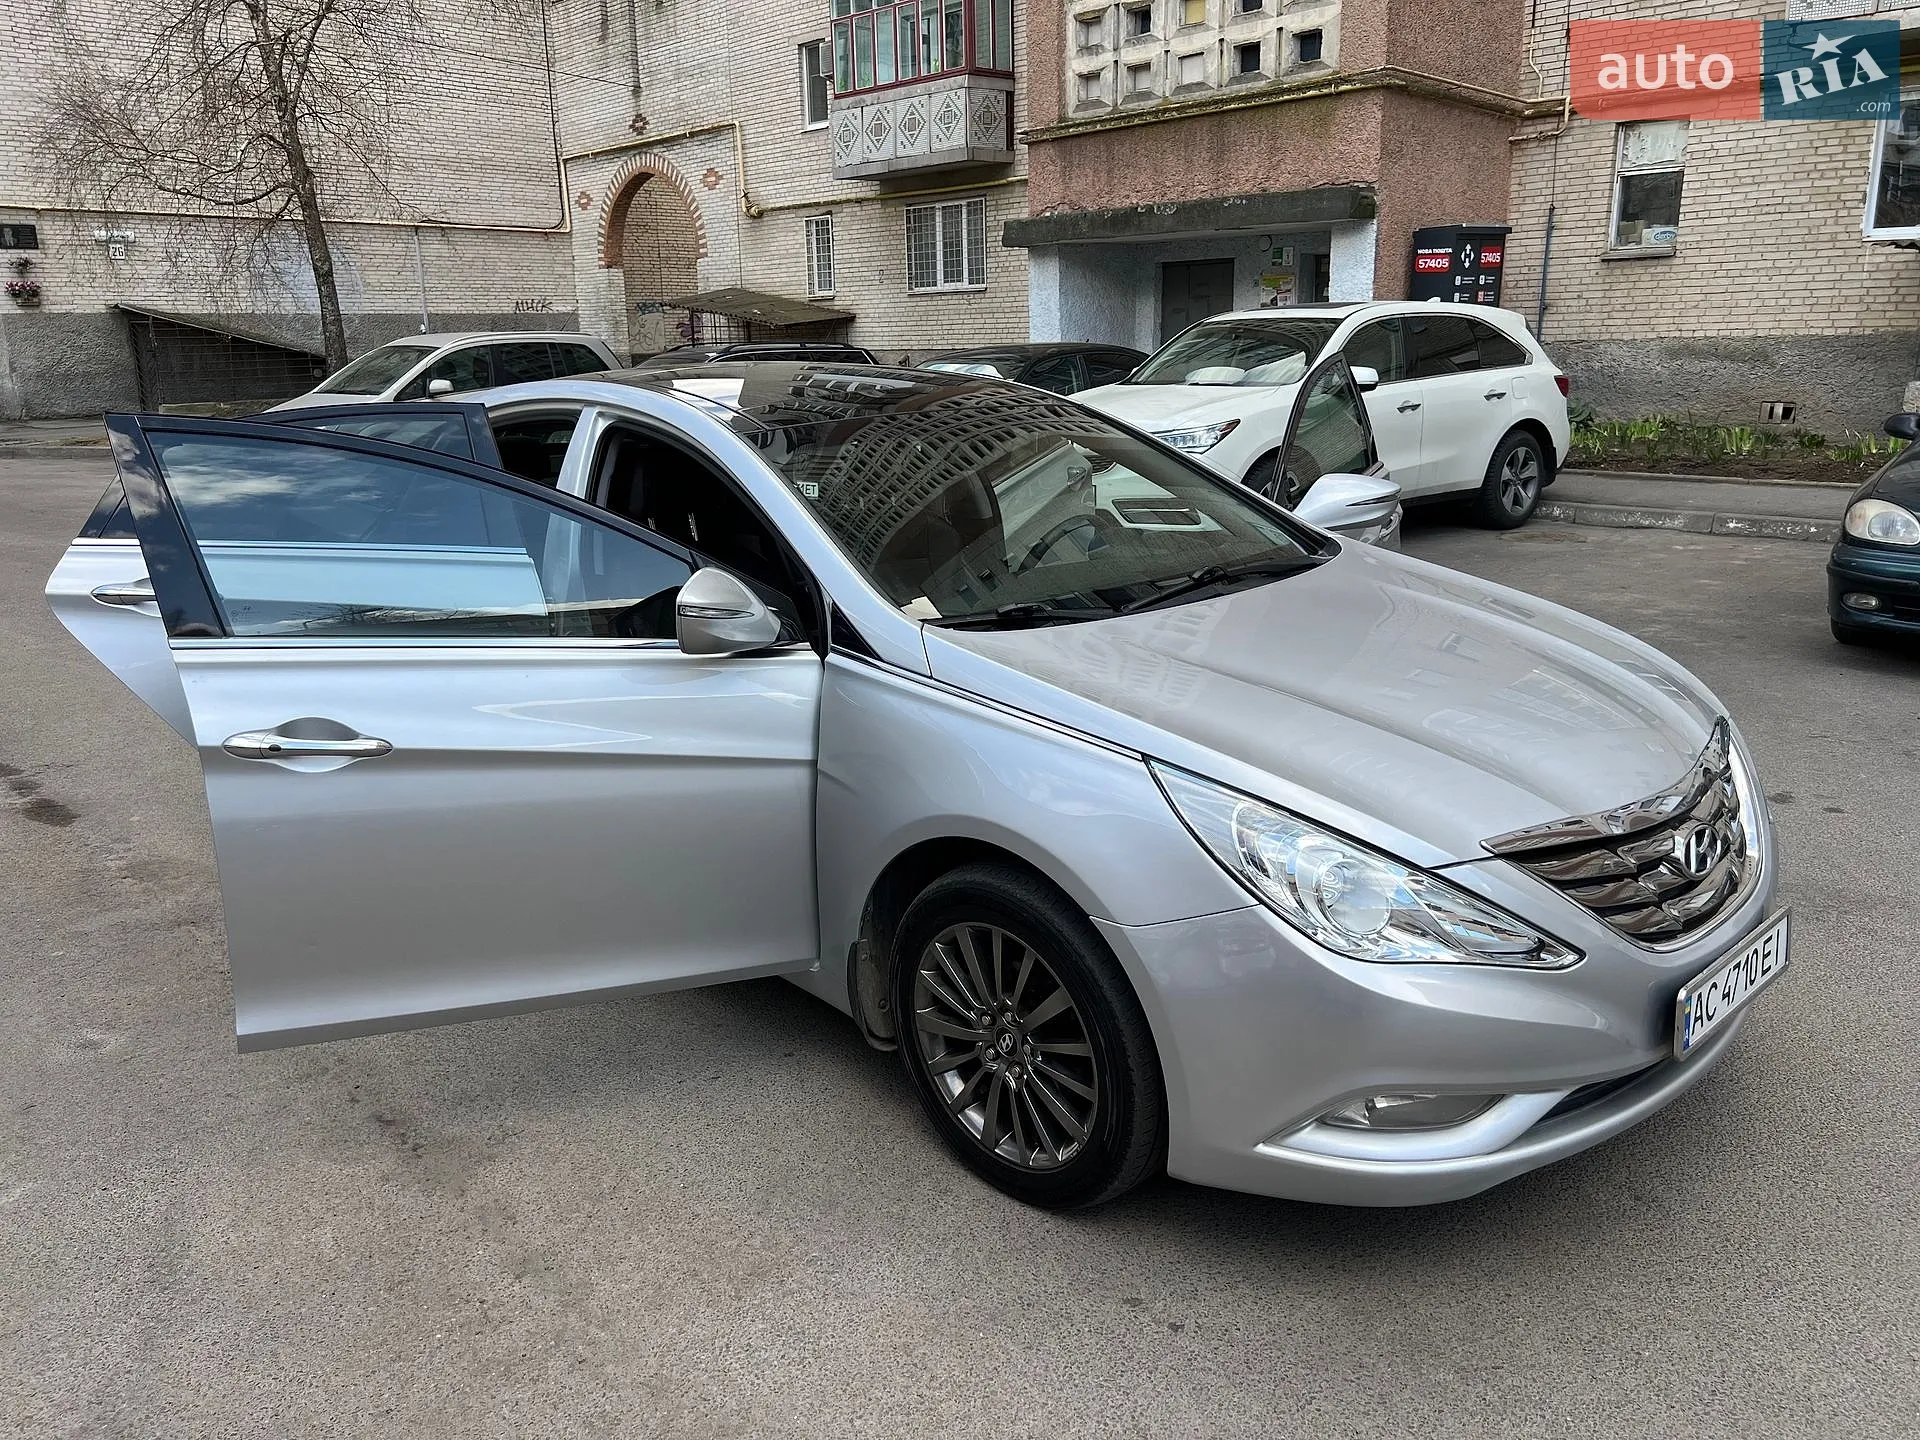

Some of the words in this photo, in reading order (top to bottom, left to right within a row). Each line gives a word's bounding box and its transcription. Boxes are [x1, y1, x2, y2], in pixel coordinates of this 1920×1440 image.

[112, 246, 124, 257] 26
[1418, 258, 1449, 268] 57405
[1480, 252, 1501, 263] 57405
[1691, 981, 1718, 1036] AC
[1721, 947, 1759, 1008] 4710
